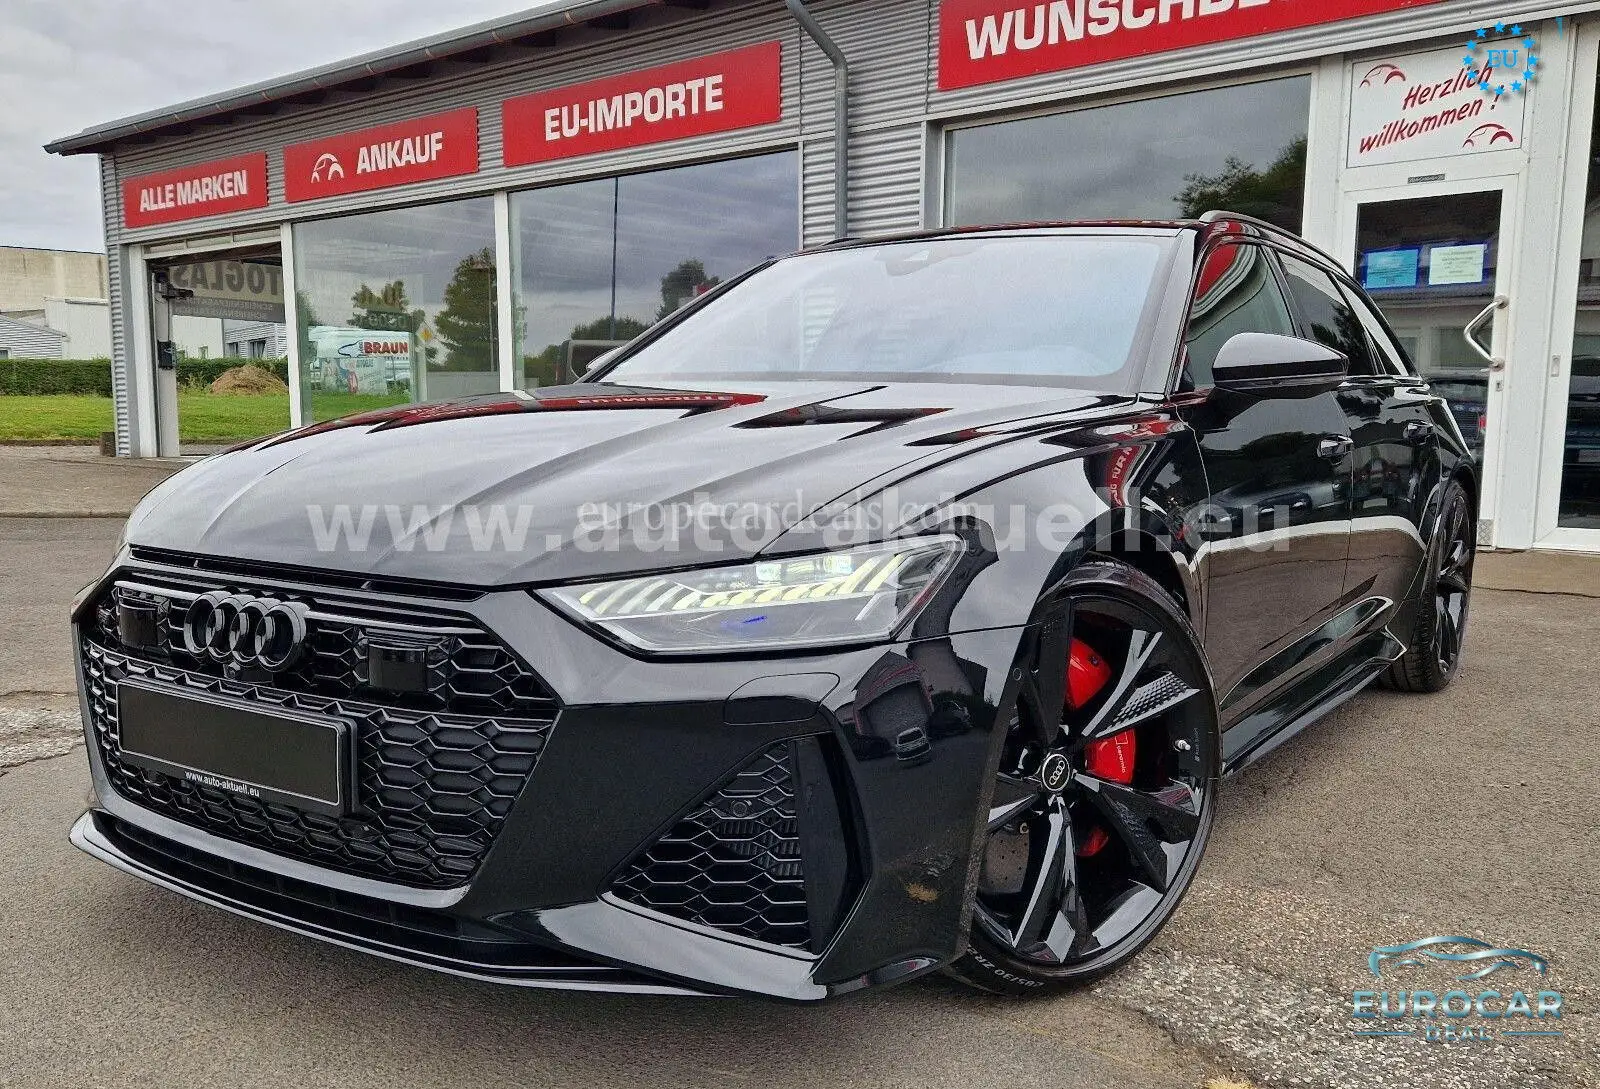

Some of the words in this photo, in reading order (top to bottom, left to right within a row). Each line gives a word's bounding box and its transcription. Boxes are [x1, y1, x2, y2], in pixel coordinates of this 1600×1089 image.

[1401, 59, 1495, 111] Herzlich
[544, 74, 723, 142] EU-IMPORTE
[1359, 97, 1484, 154] willkommen
[356, 131, 443, 175] ANKAUF
[139, 183, 175, 213] ALLE
[176, 169, 248, 206] MARKEN
[363, 341, 409, 354] BRAUN
[184, 770, 260, 798] www.auto-aktuell.eu
